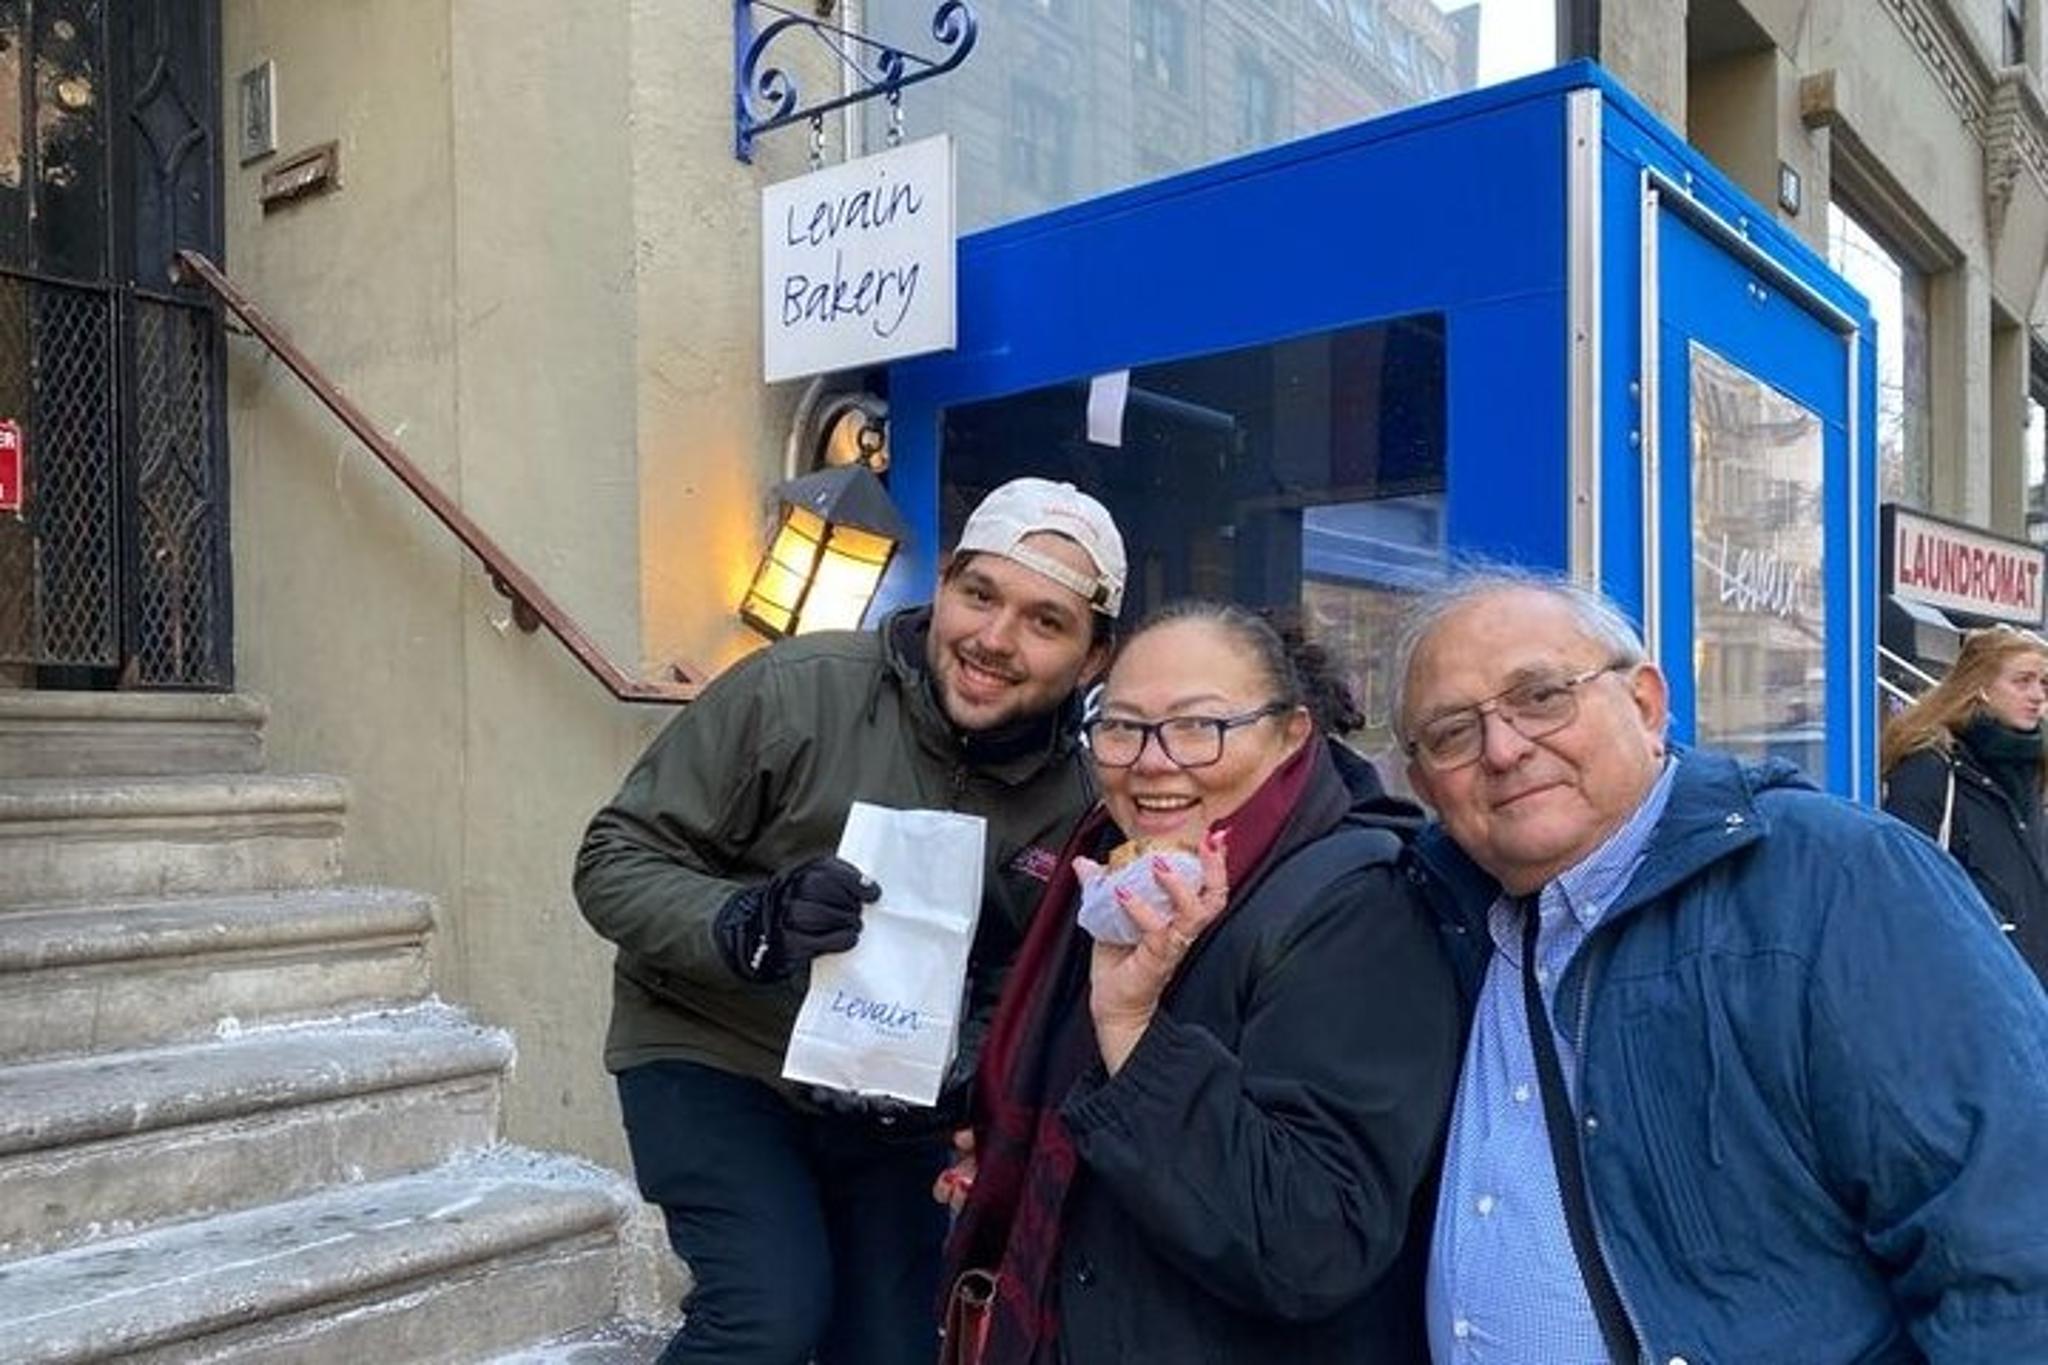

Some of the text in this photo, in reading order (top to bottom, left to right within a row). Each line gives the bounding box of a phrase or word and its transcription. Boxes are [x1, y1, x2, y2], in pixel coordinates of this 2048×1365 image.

[786, 170, 923, 247] Levain
[782, 249, 920, 339] Bakery
[1898, 527, 2039, 609] LAUNDROMAT
